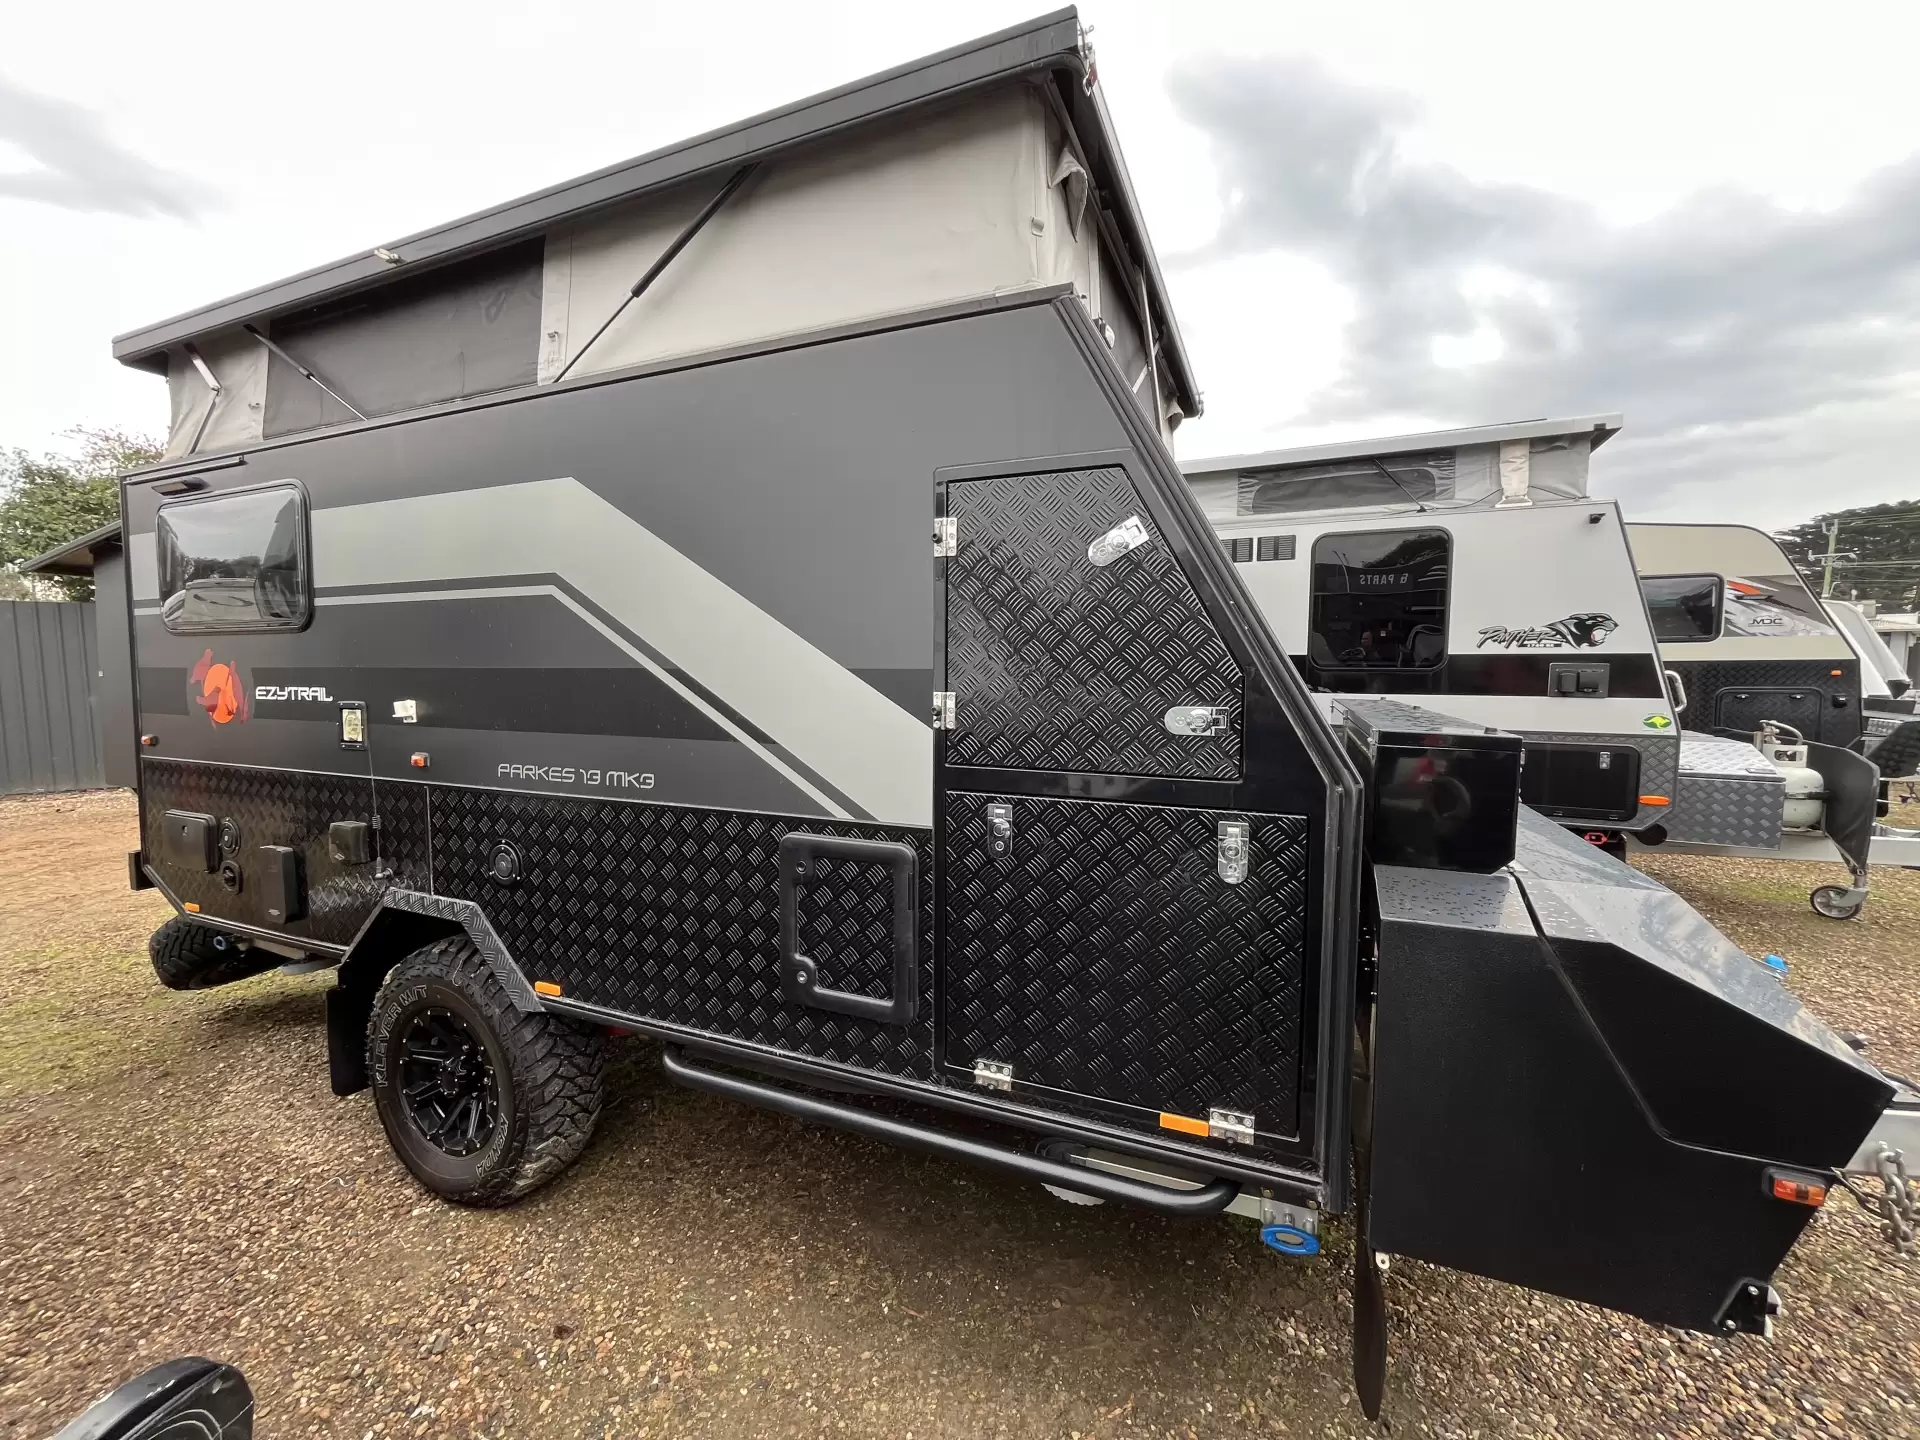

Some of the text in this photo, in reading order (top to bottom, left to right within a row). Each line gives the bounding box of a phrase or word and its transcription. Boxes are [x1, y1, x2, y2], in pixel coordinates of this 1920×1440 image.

[1476, 625, 1567, 649] PANTHER
[255, 686, 333, 701] EZYTRAIL
[498, 763, 655, 788] PARKES 13 MK3
[376, 1002, 402, 1088] KLEVER
[476, 1112, 509, 1178] KENDA
